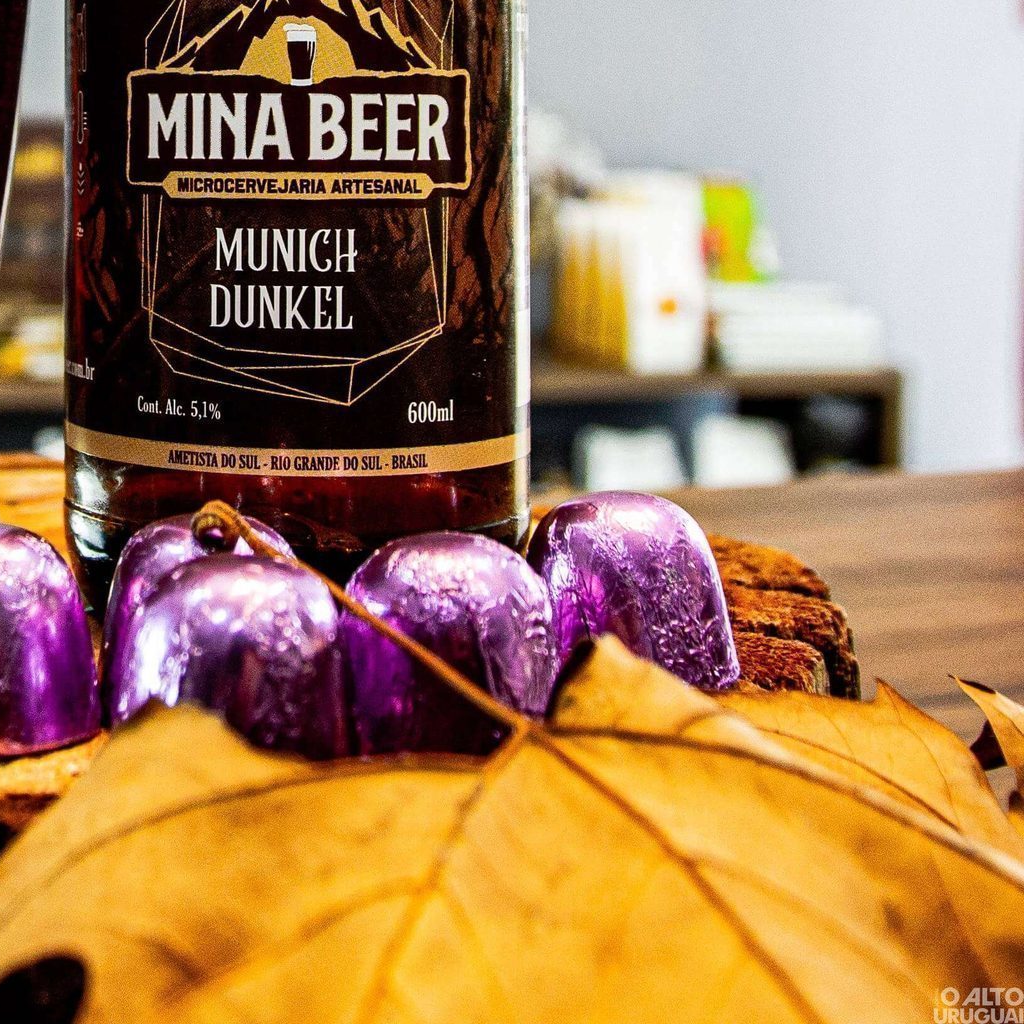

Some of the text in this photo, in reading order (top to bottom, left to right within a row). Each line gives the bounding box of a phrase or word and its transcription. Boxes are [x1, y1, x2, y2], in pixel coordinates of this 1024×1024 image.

[147, 92, 452, 161] MINA BEER
[177, 178, 422, 194] MICROCERVEJARIA ARTESANAL
[214, 227, 358, 273] MUNICH
[209, 283, 354, 330] DUNKEL
[137, 395, 221, 420] Cont. Alc. 5,1%
[407, 399, 454, 424] 600ml
[168, 449, 218, 467] AMETISTA
[221, 453, 236, 468] DO
[239, 454, 260, 469] SUL
[270, 455, 291, 471] RIO
[294, 456, 339, 471] GRANDE
[343, 456, 358, 471] DO
[361, 455, 382, 470] SUL
[391, 453, 428, 469] BRASIL
